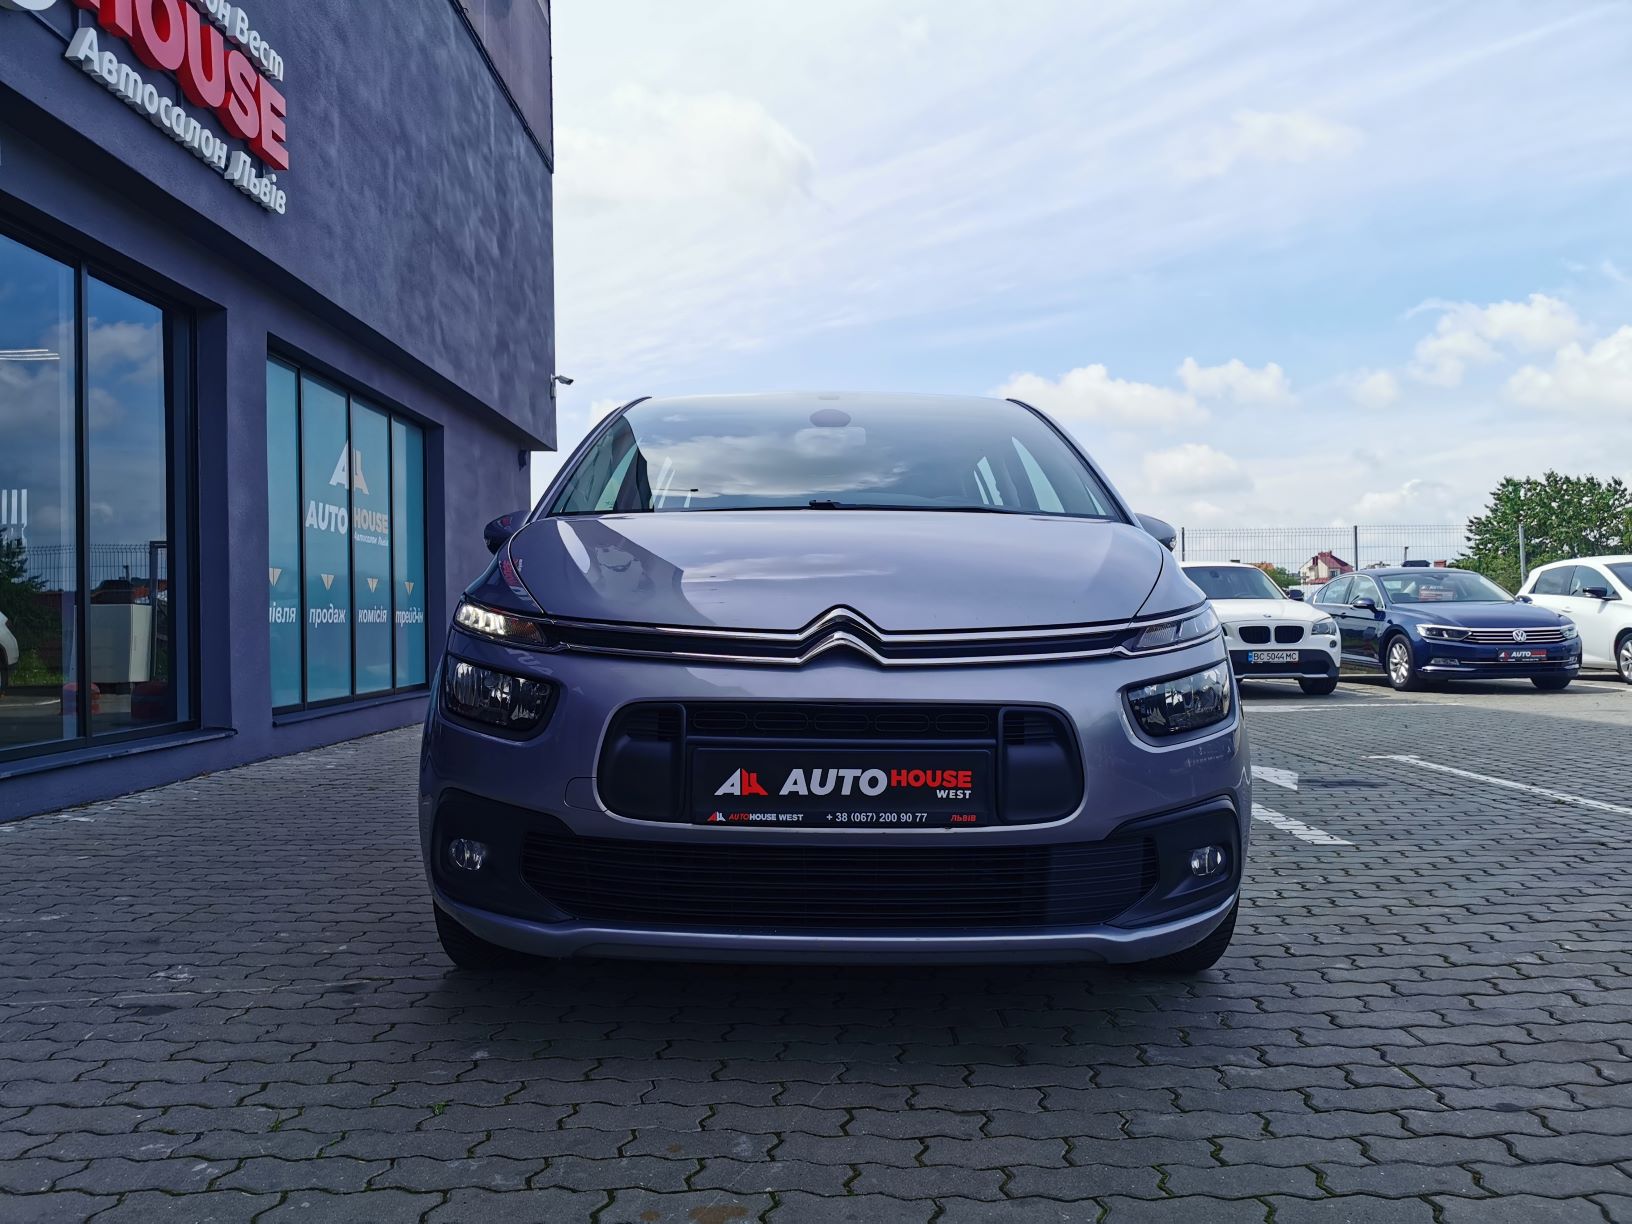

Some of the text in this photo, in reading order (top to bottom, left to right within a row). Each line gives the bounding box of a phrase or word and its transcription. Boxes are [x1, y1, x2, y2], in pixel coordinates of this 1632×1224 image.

[227, 7, 284, 82] Вест
[65, 27, 287, 215] Автосалон Львів
[305, 500, 388, 535] AUTO HOUSE
[309, 603, 346, 628] продаж
[358, 605, 387, 623] комісія
[395, 607, 424, 628] трейд-ін
[1253, 653, 1297, 661] BC 5044 MC
[779, 768, 972, 796] AUTO HOUSE
[936, 789, 972, 799] WEST
[778, 813, 804, 821] WEST
[835, 813, 848, 822] 38
[850, 812, 877, 823] (067)
[879, 813, 898, 822] 200
[900, 813, 913, 822] 90
[915, 813, 928, 822] 77
